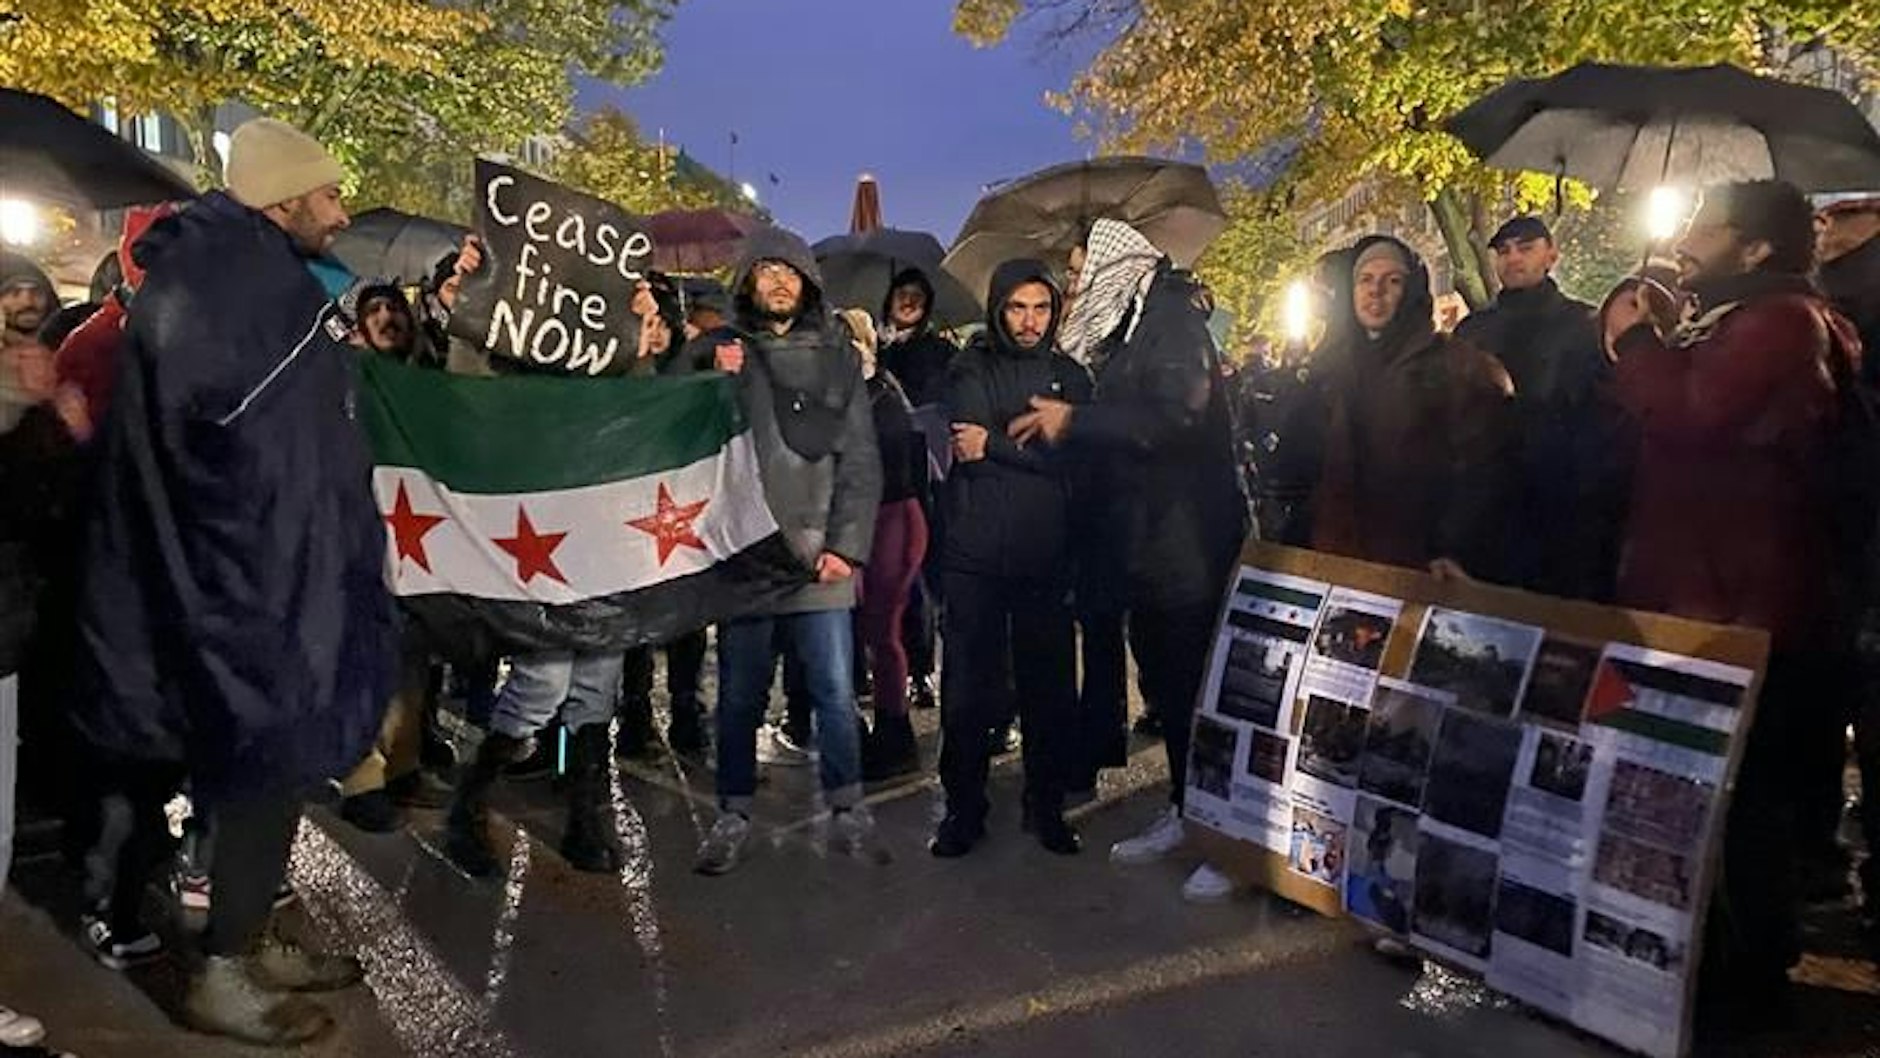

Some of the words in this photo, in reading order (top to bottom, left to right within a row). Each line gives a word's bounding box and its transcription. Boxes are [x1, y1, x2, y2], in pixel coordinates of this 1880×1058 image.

[487, 175, 651, 280] Cease
[516, 244, 606, 330] fire
[485, 300, 619, 376] NOW
